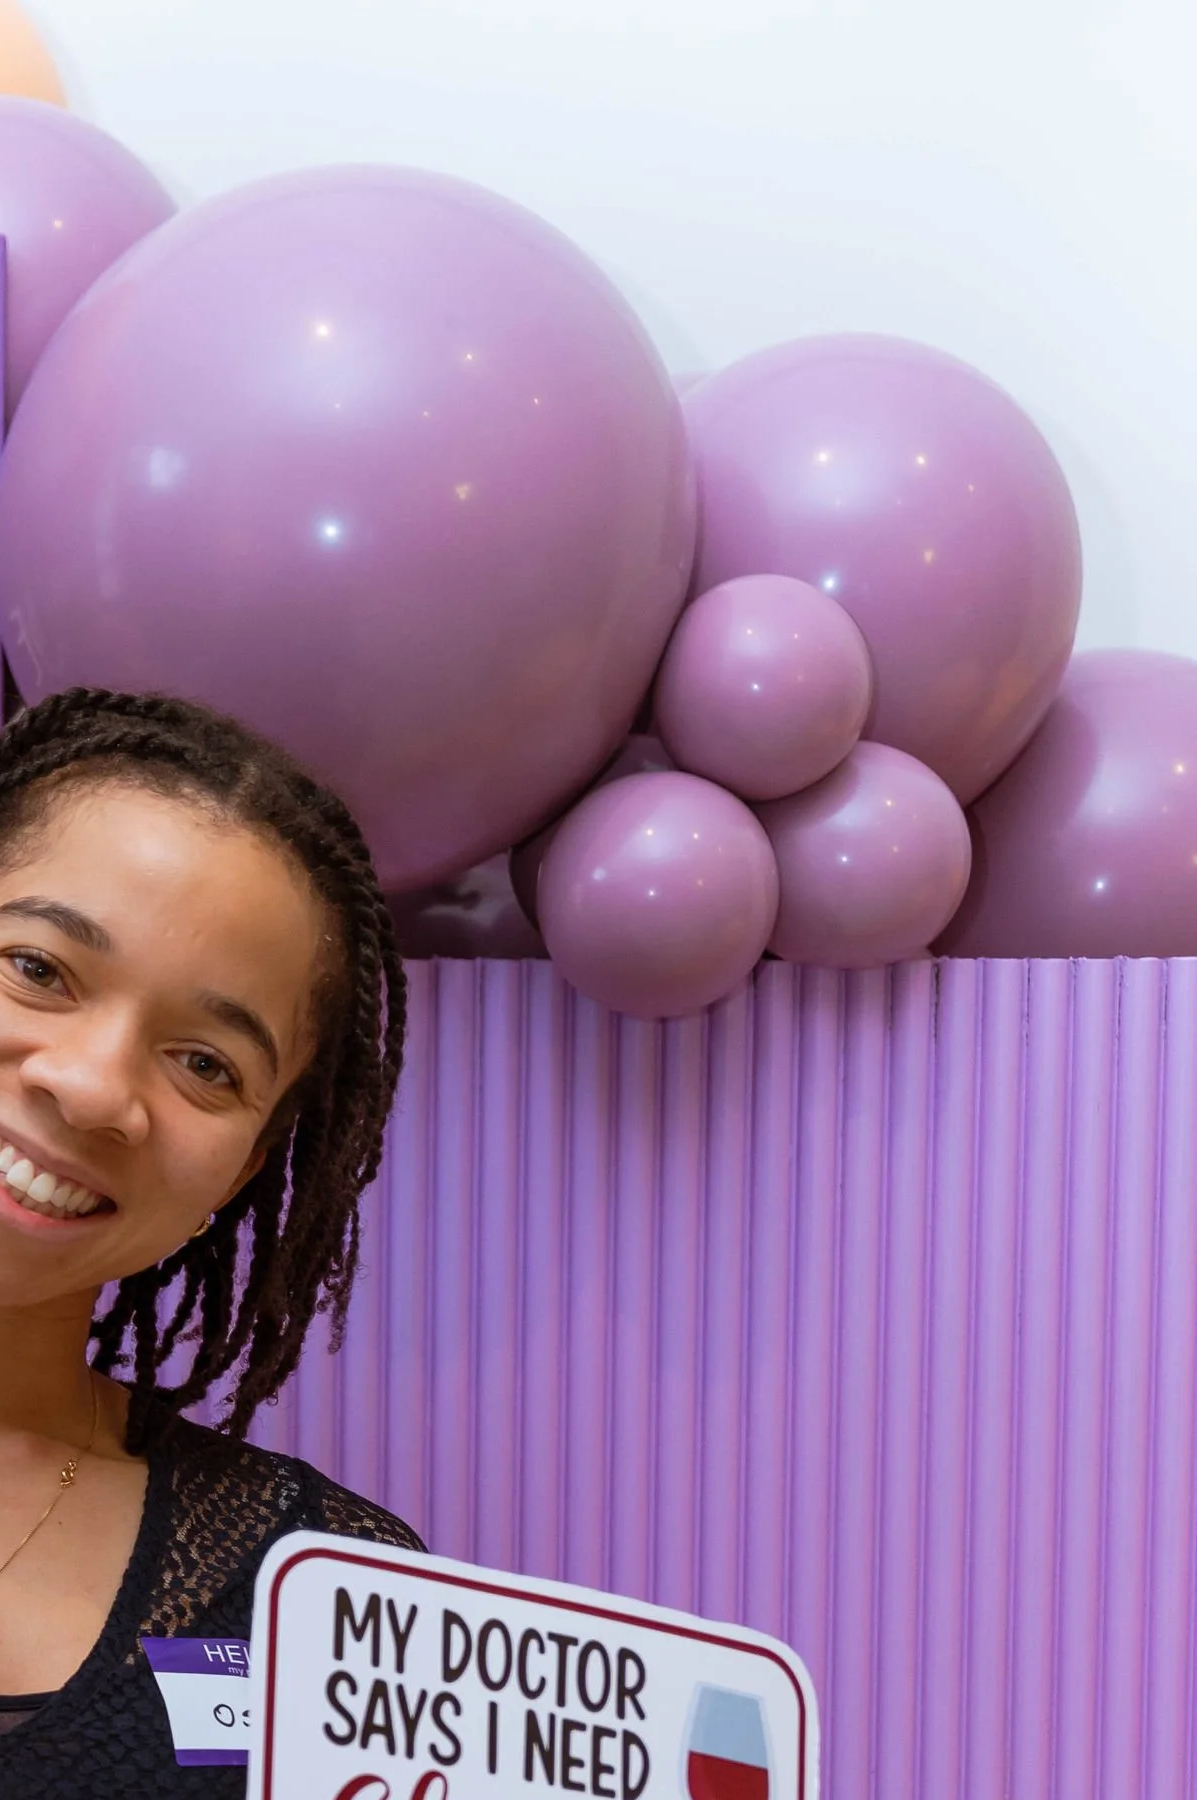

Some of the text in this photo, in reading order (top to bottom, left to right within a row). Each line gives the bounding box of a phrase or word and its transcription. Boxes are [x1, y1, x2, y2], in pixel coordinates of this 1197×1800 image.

[333, 1587, 647, 1721] MY DOCTOR
[323, 1670, 462, 1767] SAYS
[488, 1701, 498, 1775] I
